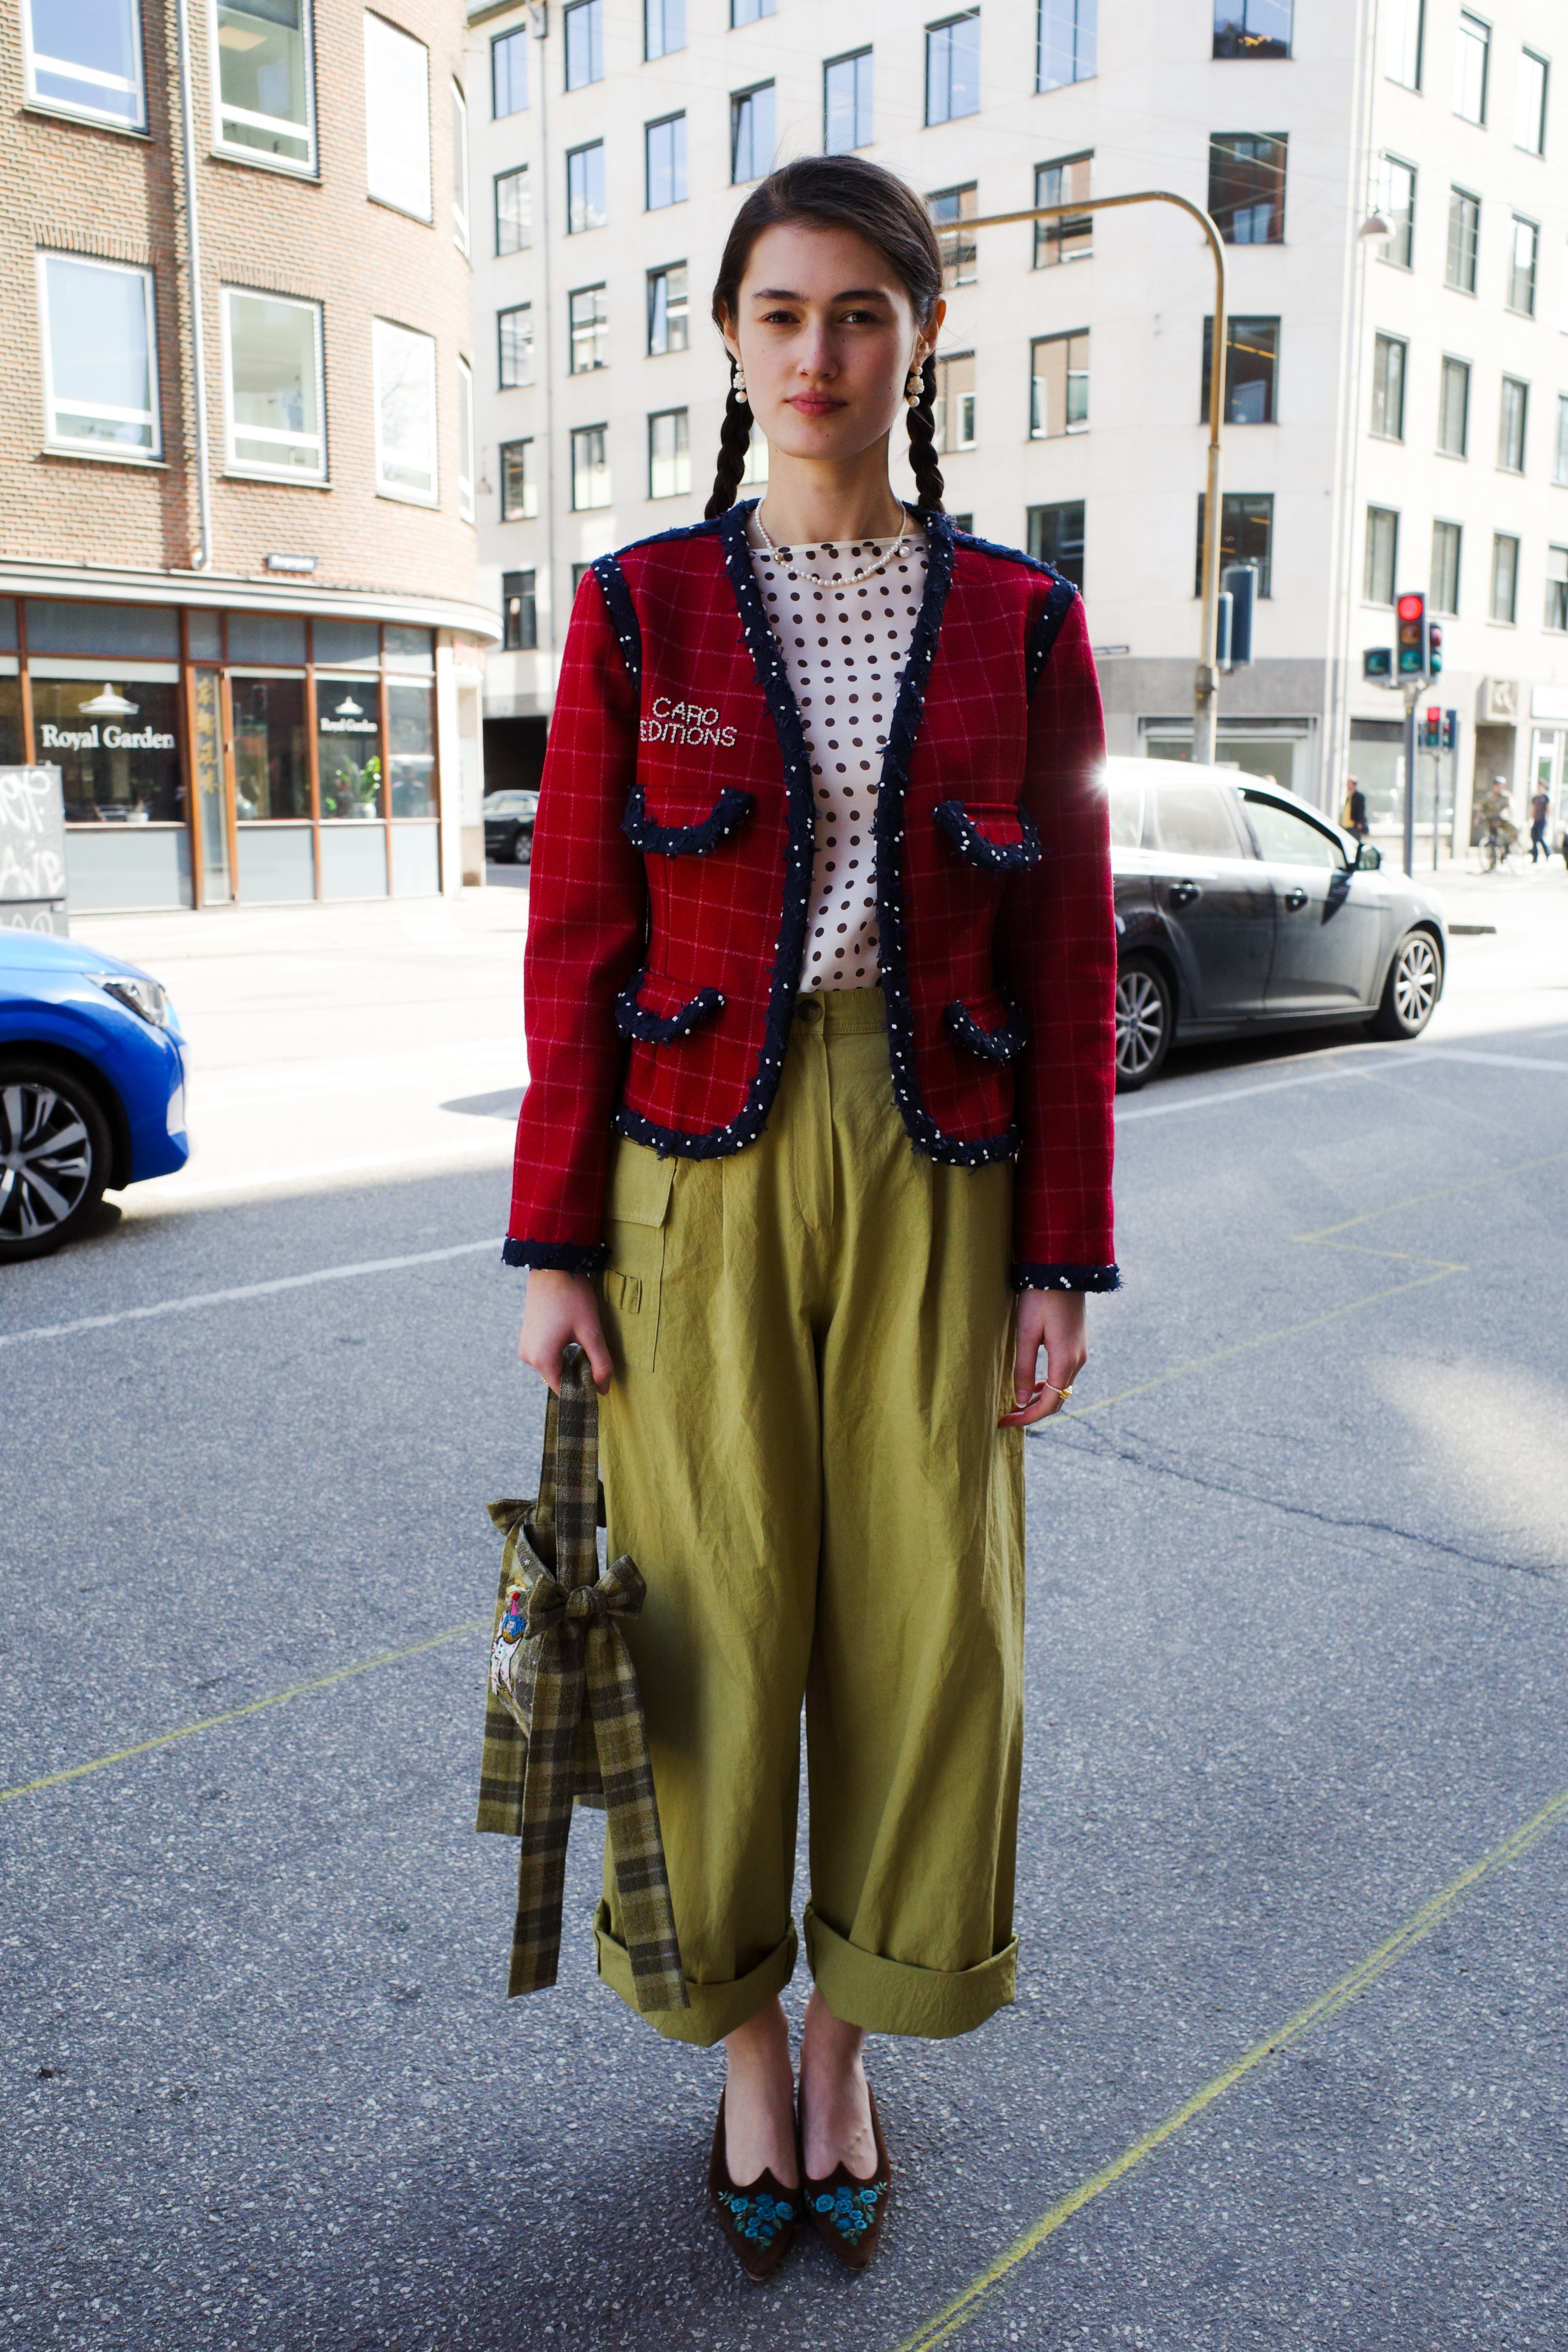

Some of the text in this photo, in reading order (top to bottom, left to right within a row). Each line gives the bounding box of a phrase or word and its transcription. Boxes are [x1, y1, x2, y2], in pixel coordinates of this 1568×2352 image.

[652, 696, 719, 726] CARO
[40, 724, 176, 751] Royal Garden
[640, 719, 738, 747] EDITIONS
